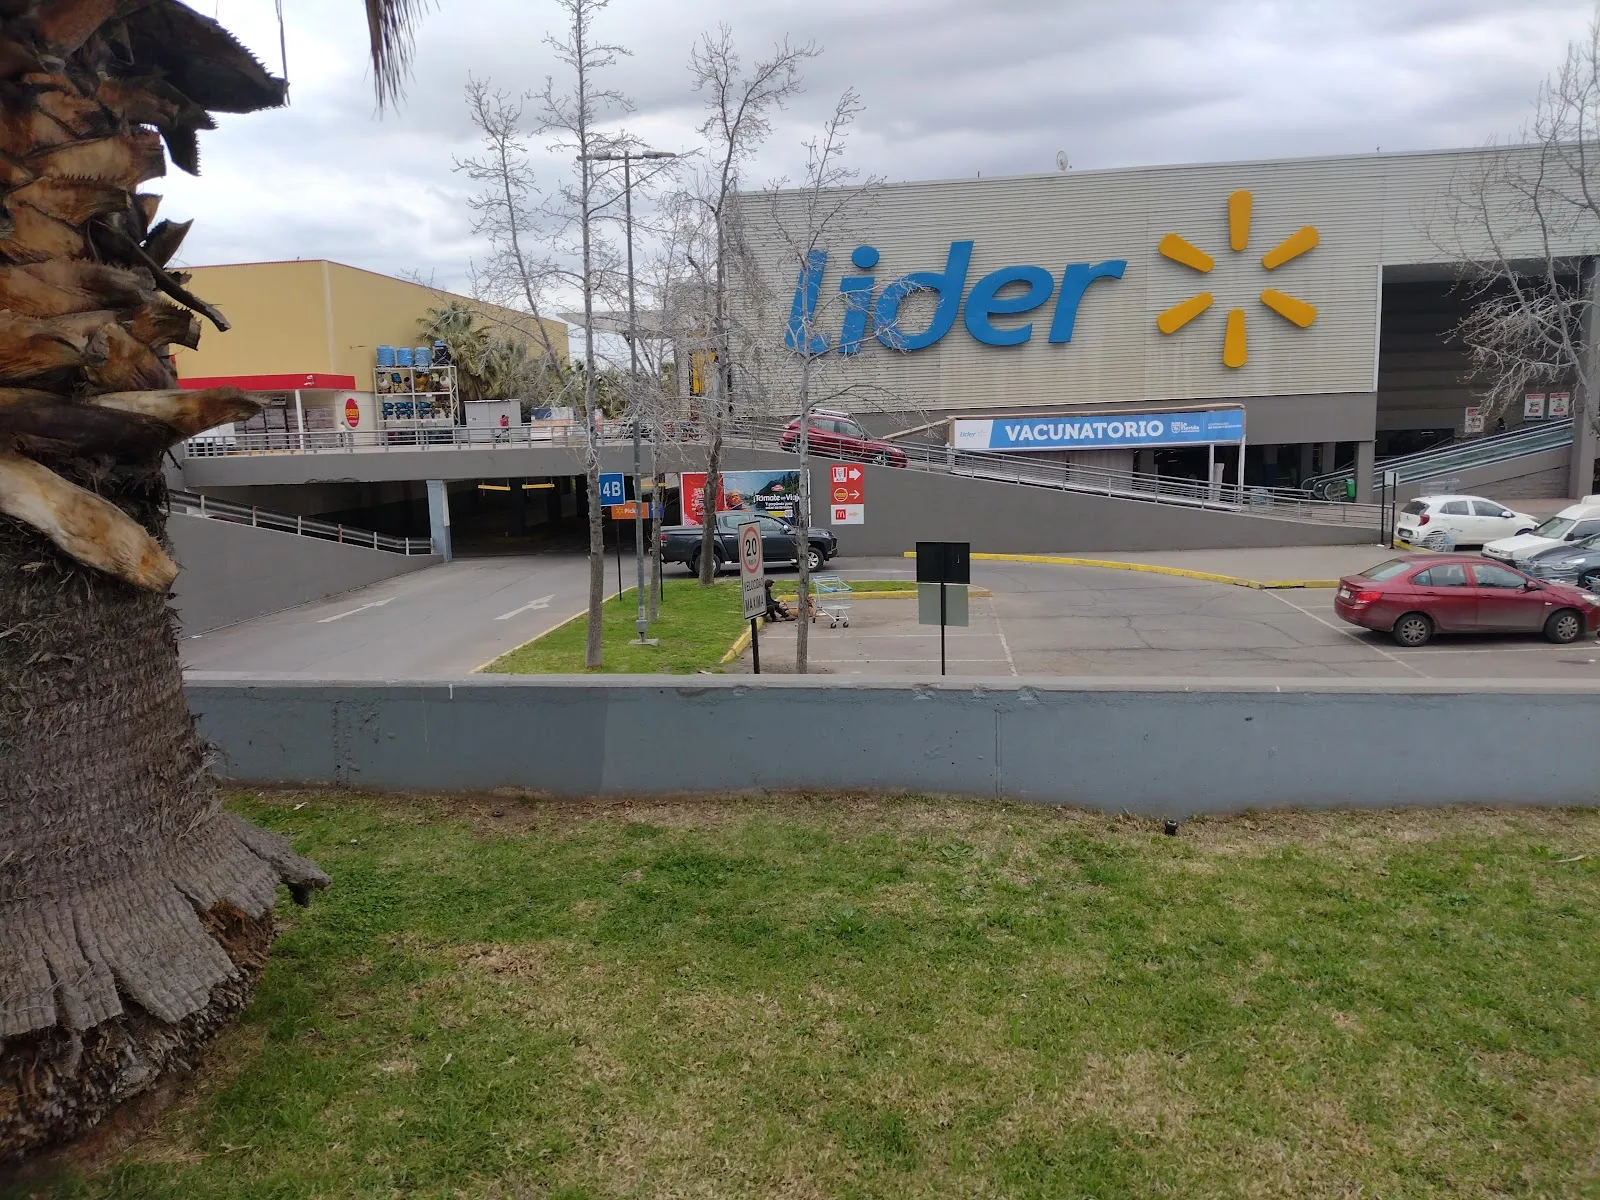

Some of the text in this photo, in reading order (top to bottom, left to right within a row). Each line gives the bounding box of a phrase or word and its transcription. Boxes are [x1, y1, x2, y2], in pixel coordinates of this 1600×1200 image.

[1005, 420, 1164, 442] VACUNATORIO
[602, 481, 621, 497] 4B
[746, 537, 757, 557] 20
